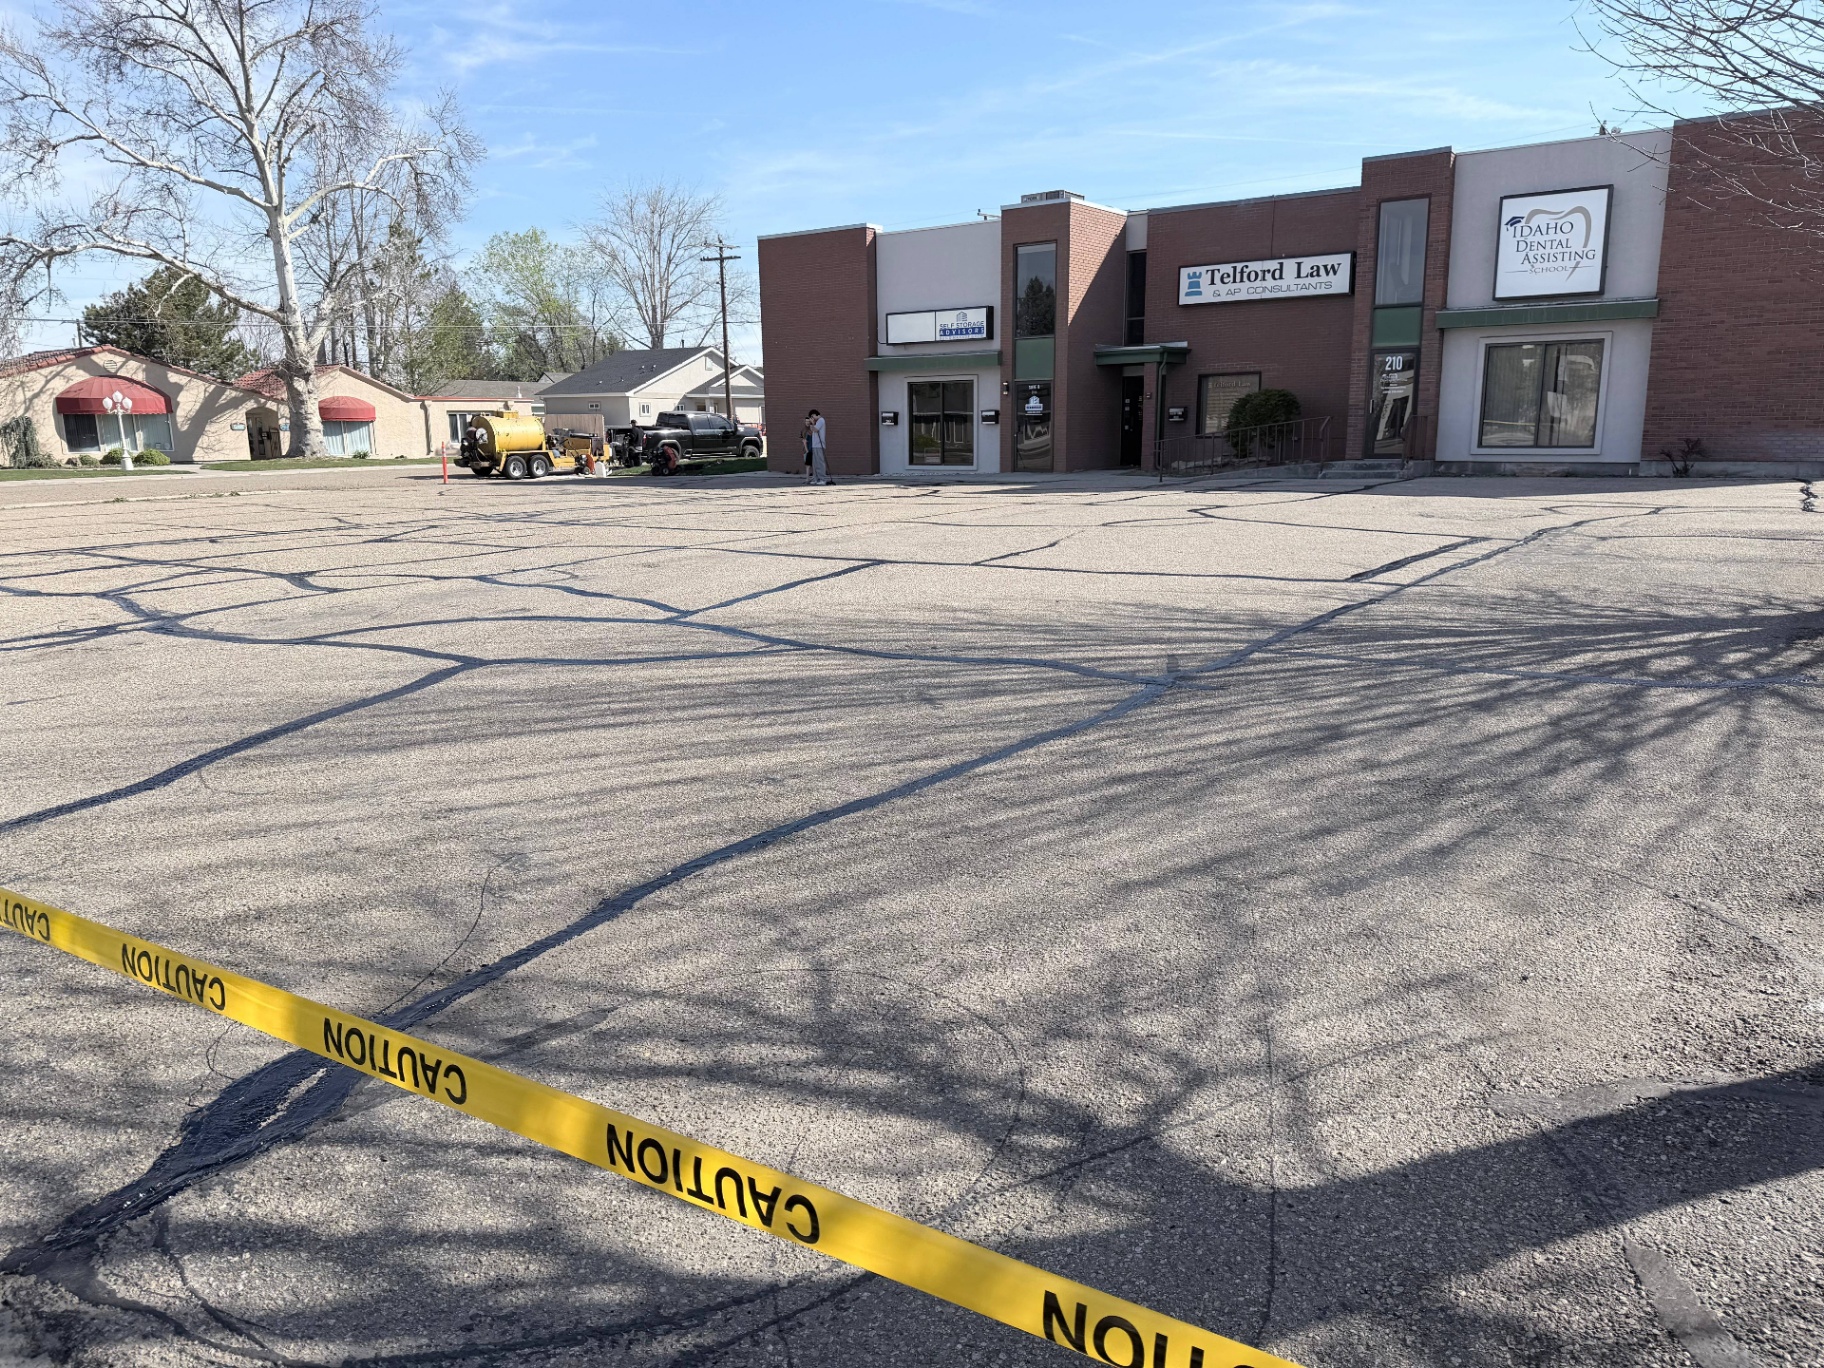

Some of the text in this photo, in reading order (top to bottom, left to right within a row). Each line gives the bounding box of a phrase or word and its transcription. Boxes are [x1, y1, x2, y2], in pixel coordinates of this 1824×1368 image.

[1513, 220, 1574, 239] IDAHO
[1515, 238, 1572, 253] DENTAL
[1521, 249, 1596, 265] ASSISTING
[1205, 261, 1342, 286] Telford Law
[1529, 265, 1570, 275] SCHOOL
[1212, 281, 1333, 298] & AP CONSULTANTS
[1385, 355, 1403, 371] 210
[0, 898, 51, 942] CAUT
[121, 943, 226, 1011] CAUTION
[323, 1017, 468, 1105] CAUTION
[606, 1123, 821, 1246] CAUTION
[1043, 1290, 1255, 1368] ION
